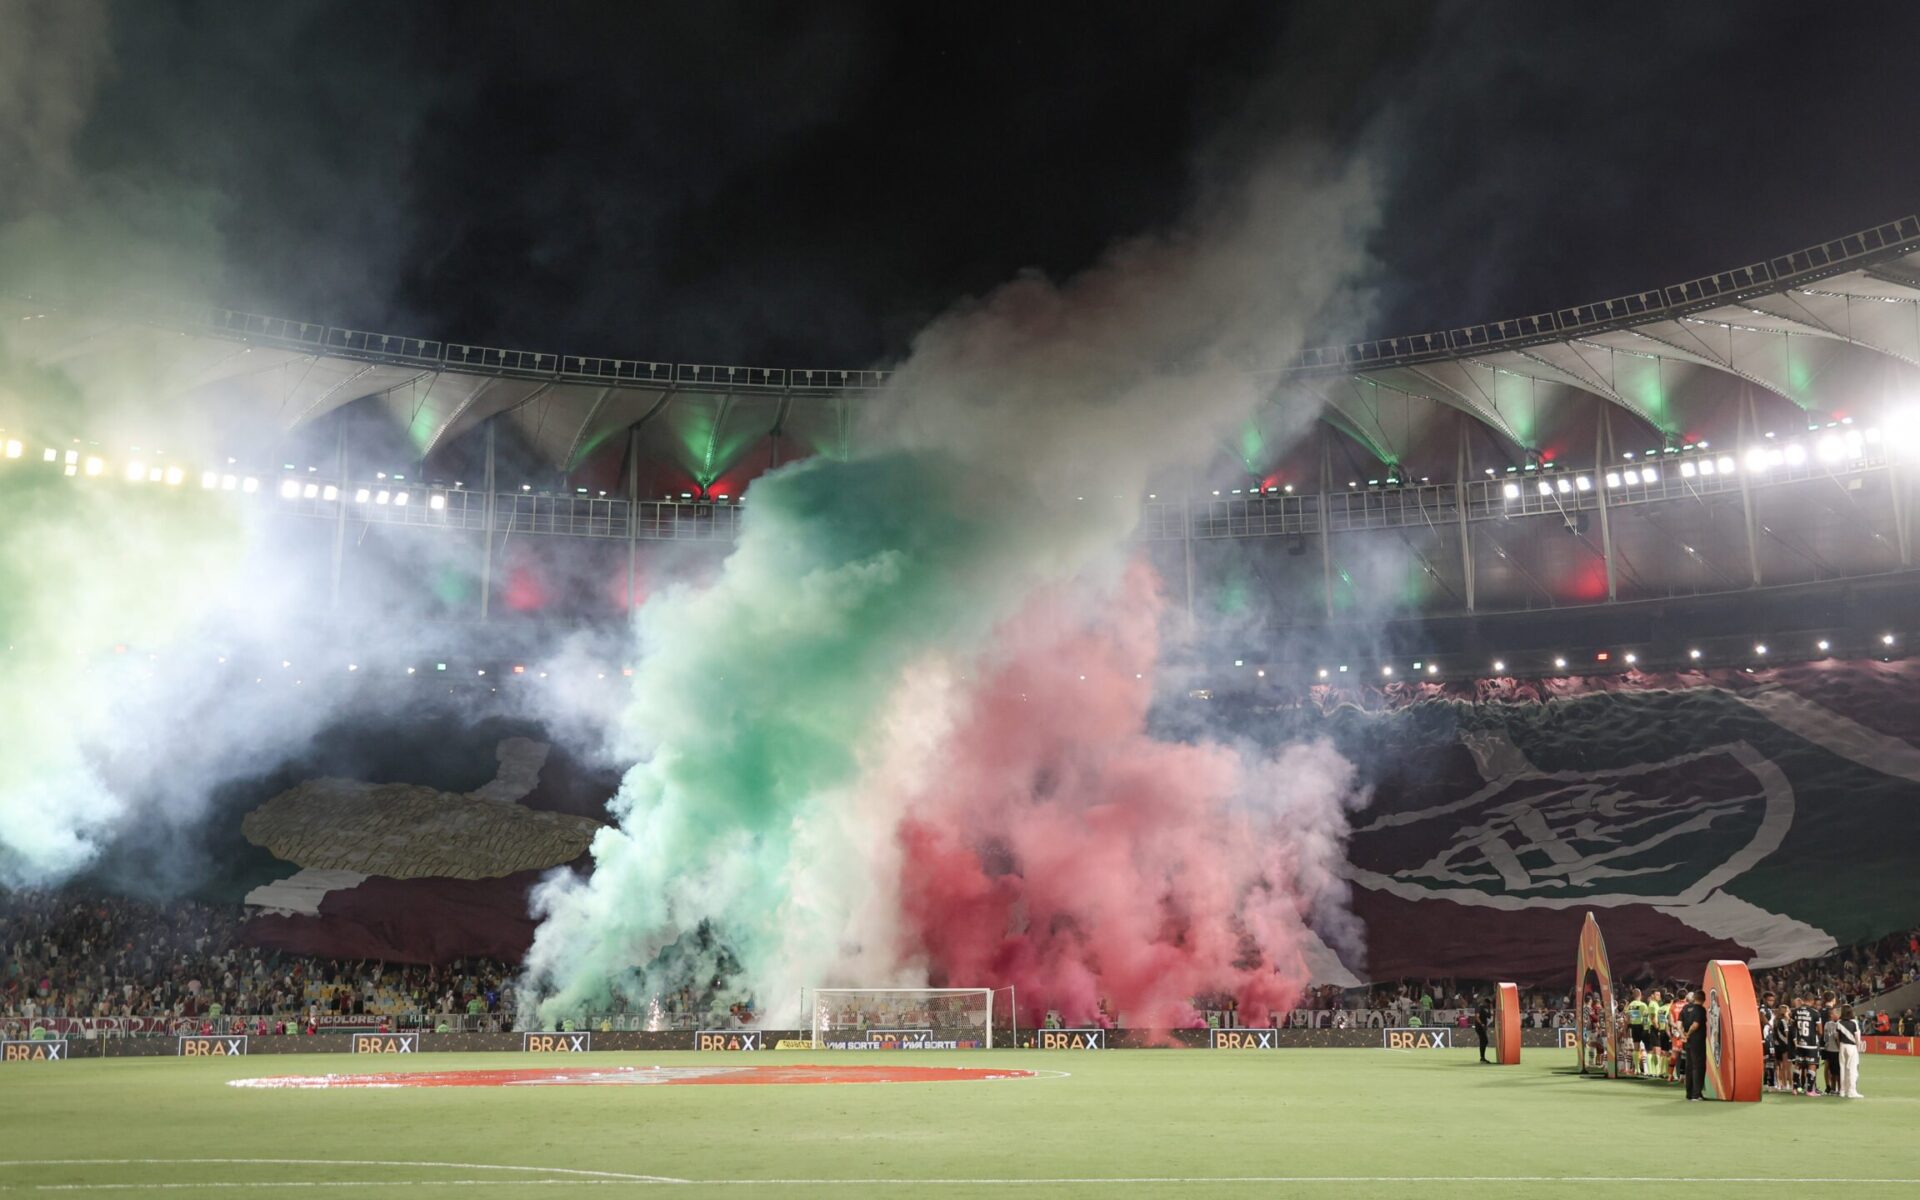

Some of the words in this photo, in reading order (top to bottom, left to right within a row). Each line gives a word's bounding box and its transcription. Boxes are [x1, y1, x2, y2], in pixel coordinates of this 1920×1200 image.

[185, 1040, 241, 1056] BRAX
[359, 1037, 413, 1053] BRAX
[529, 1036, 584, 1052] BRAX
[701, 1035, 756, 1051] BRAX
[826, 1041, 846, 1050] VIVA
[847, 1041, 880, 1050] SORTE
[903, 1041, 923, 1050] VIVA
[924, 1041, 956, 1050] SORTE
[1044, 1033, 1098, 1049] BRAX
[1216, 1033, 1271, 1049] BRAX
[1390, 1032, 1445, 1048] BRAX
[7, 1044, 61, 1061] BRAX
